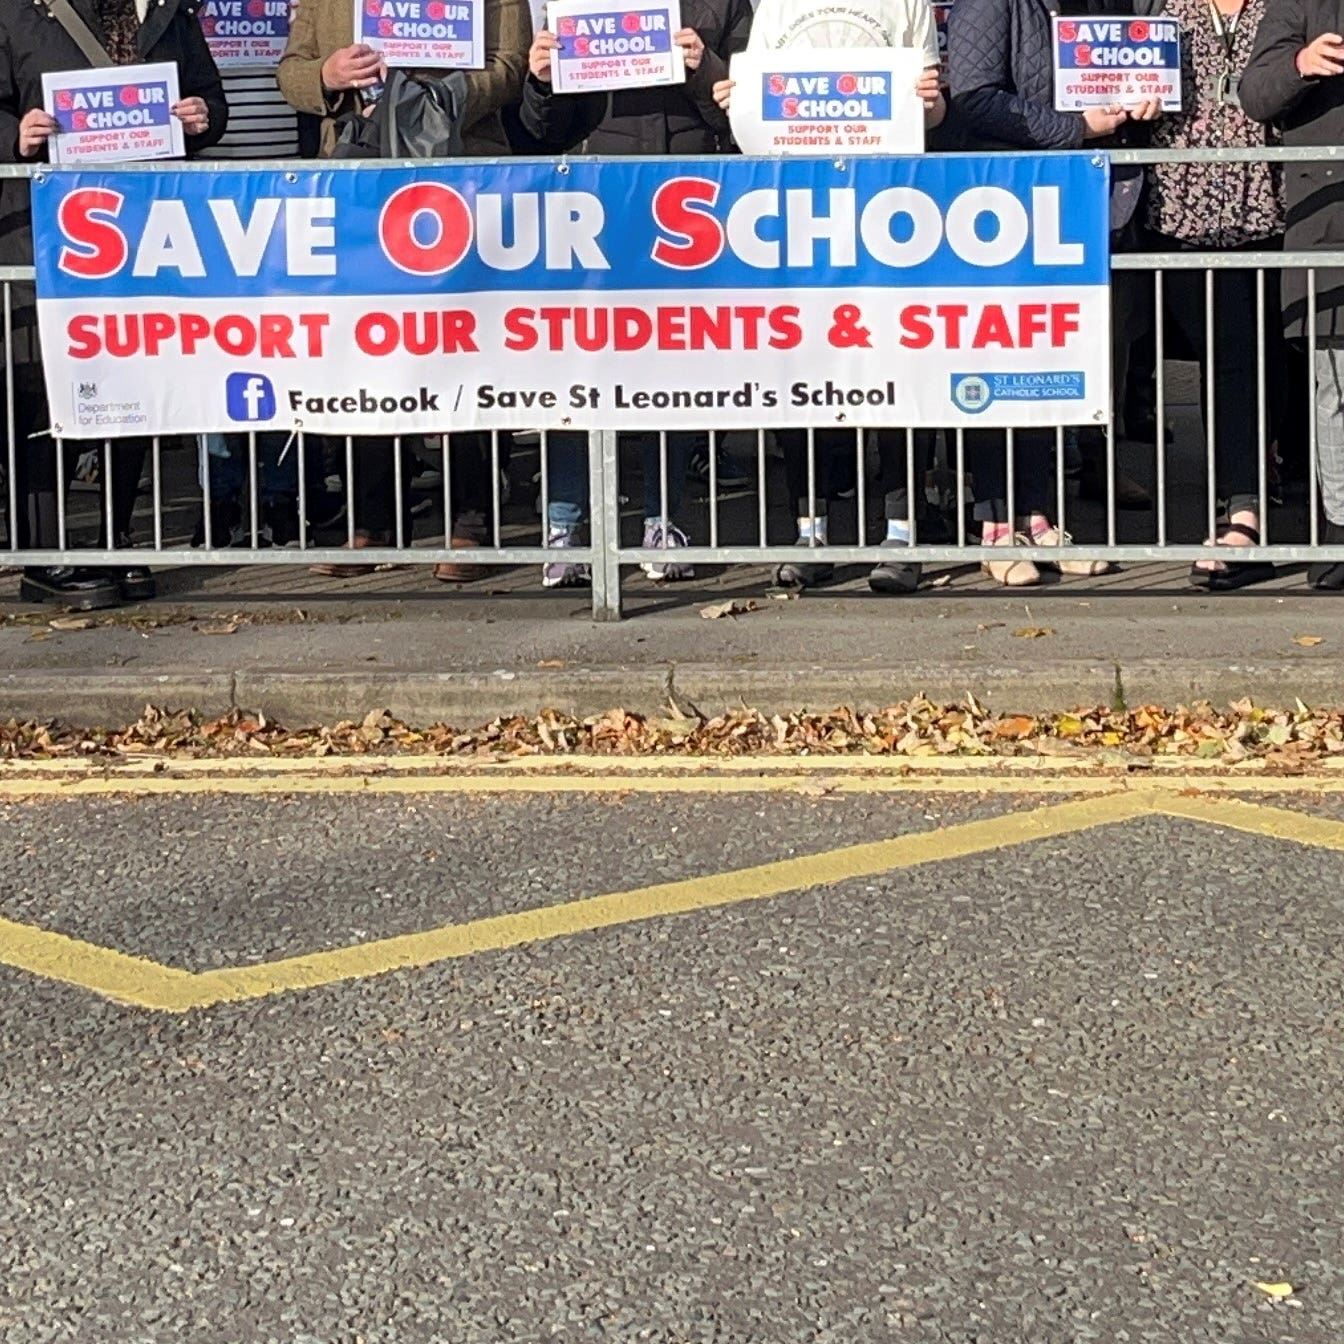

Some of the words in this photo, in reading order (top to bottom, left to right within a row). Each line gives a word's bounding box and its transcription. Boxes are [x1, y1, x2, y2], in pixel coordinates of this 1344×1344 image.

[247, 0, 287, 18] OUR
[427, 1, 469, 20] OUR
[203, 18, 275, 35] SCHOOL
[378, 18, 457, 38] SCHOOL
[560, 18, 616, 36] SAVE
[622, 13, 665, 33] OUR
[1059, 21, 1121, 43] SAVE
[1129, 21, 1176, 42] OUR
[574, 36, 655, 56] SCHOOL
[1074, 44, 1165, 66] SCHOOL
[769, 75, 829, 96] SAVE
[837, 74, 886, 96] OUR
[56, 91, 114, 110] SAVE
[120, 86, 164, 106] OUR
[783, 98, 872, 118] SCHOOL
[72, 109, 154, 130] SCHOOL
[58, 187, 337, 279] SAVE
[378, 182, 611, 276] OUR
[651, 176, 1084, 270] SCHOOL
[67, 313, 329, 359] SUPPORT
[356, 310, 479, 356] OUR
[504, 305, 802, 351] STUDENTS
[828, 304, 873, 348] &
[900, 303, 1080, 349] STAFF
[994, 376, 1007, 385] ST
[1013, 374, 1080, 385] LEONARD'S
[289, 388, 440, 413] Facebook
[477, 385, 557, 408] Save
[569, 384, 601, 408] St
[614, 382, 778, 409] Leonard's
[791, 381, 895, 406] School
[994, 388, 1040, 397] CATHOLIC
[1042, 388, 1079, 396] SCHOOL
[79, 402, 140, 414] Department
[79, 416, 92, 425] for
[96, 414, 146, 424] Education
